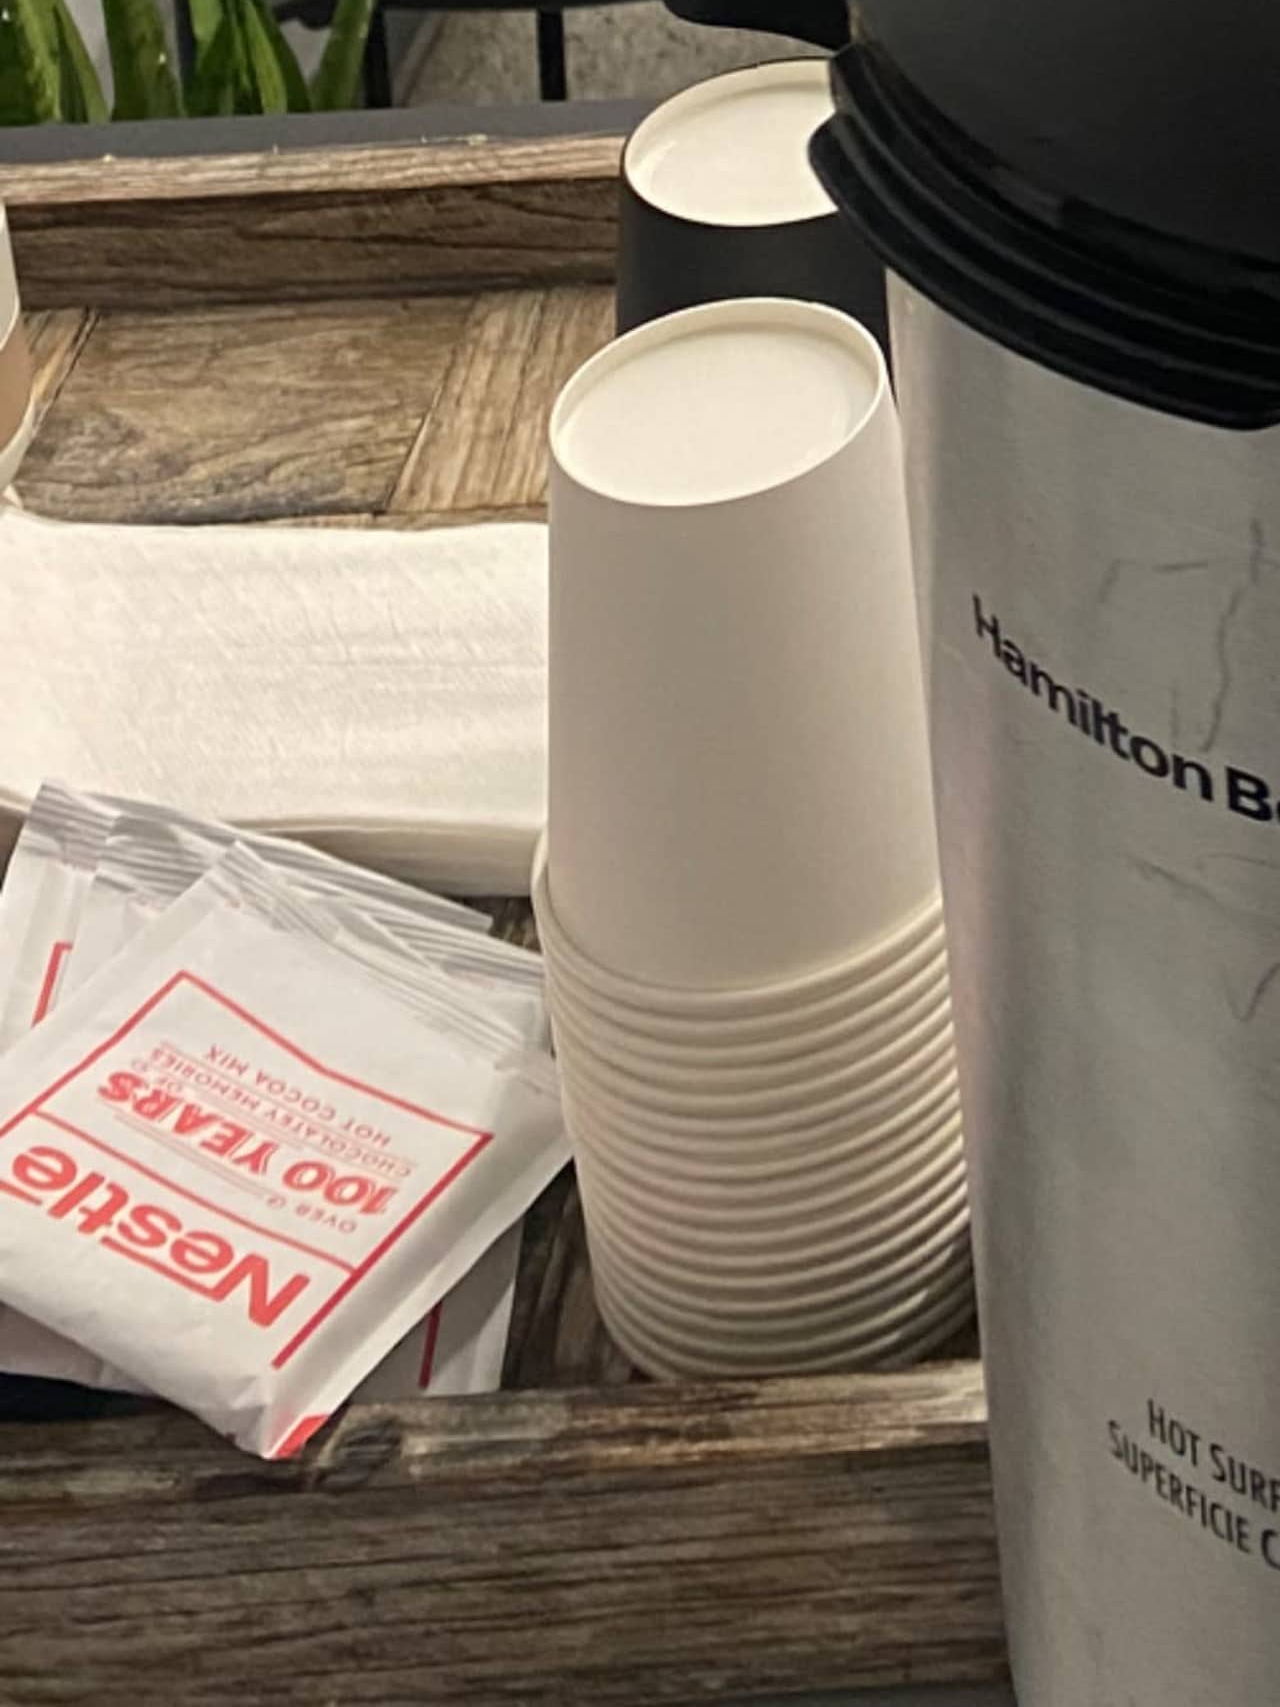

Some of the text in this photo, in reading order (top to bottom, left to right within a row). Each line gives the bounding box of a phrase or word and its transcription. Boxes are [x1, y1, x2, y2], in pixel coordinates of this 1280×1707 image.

[972, 593, 1213, 803] Hamilton
[97, 1070, 398, 1216] 100 YEARS
[151, 1047, 413, 1179] CHOCOLATEY MEMORIES
[205, 1043, 392, 1148] HOT COCOA MIX
[294, 1201, 358, 1235] OVER
[1107, 1418, 1251, 1555] SUPERFICIE
[1147, 1397, 1201, 1468] HOT
